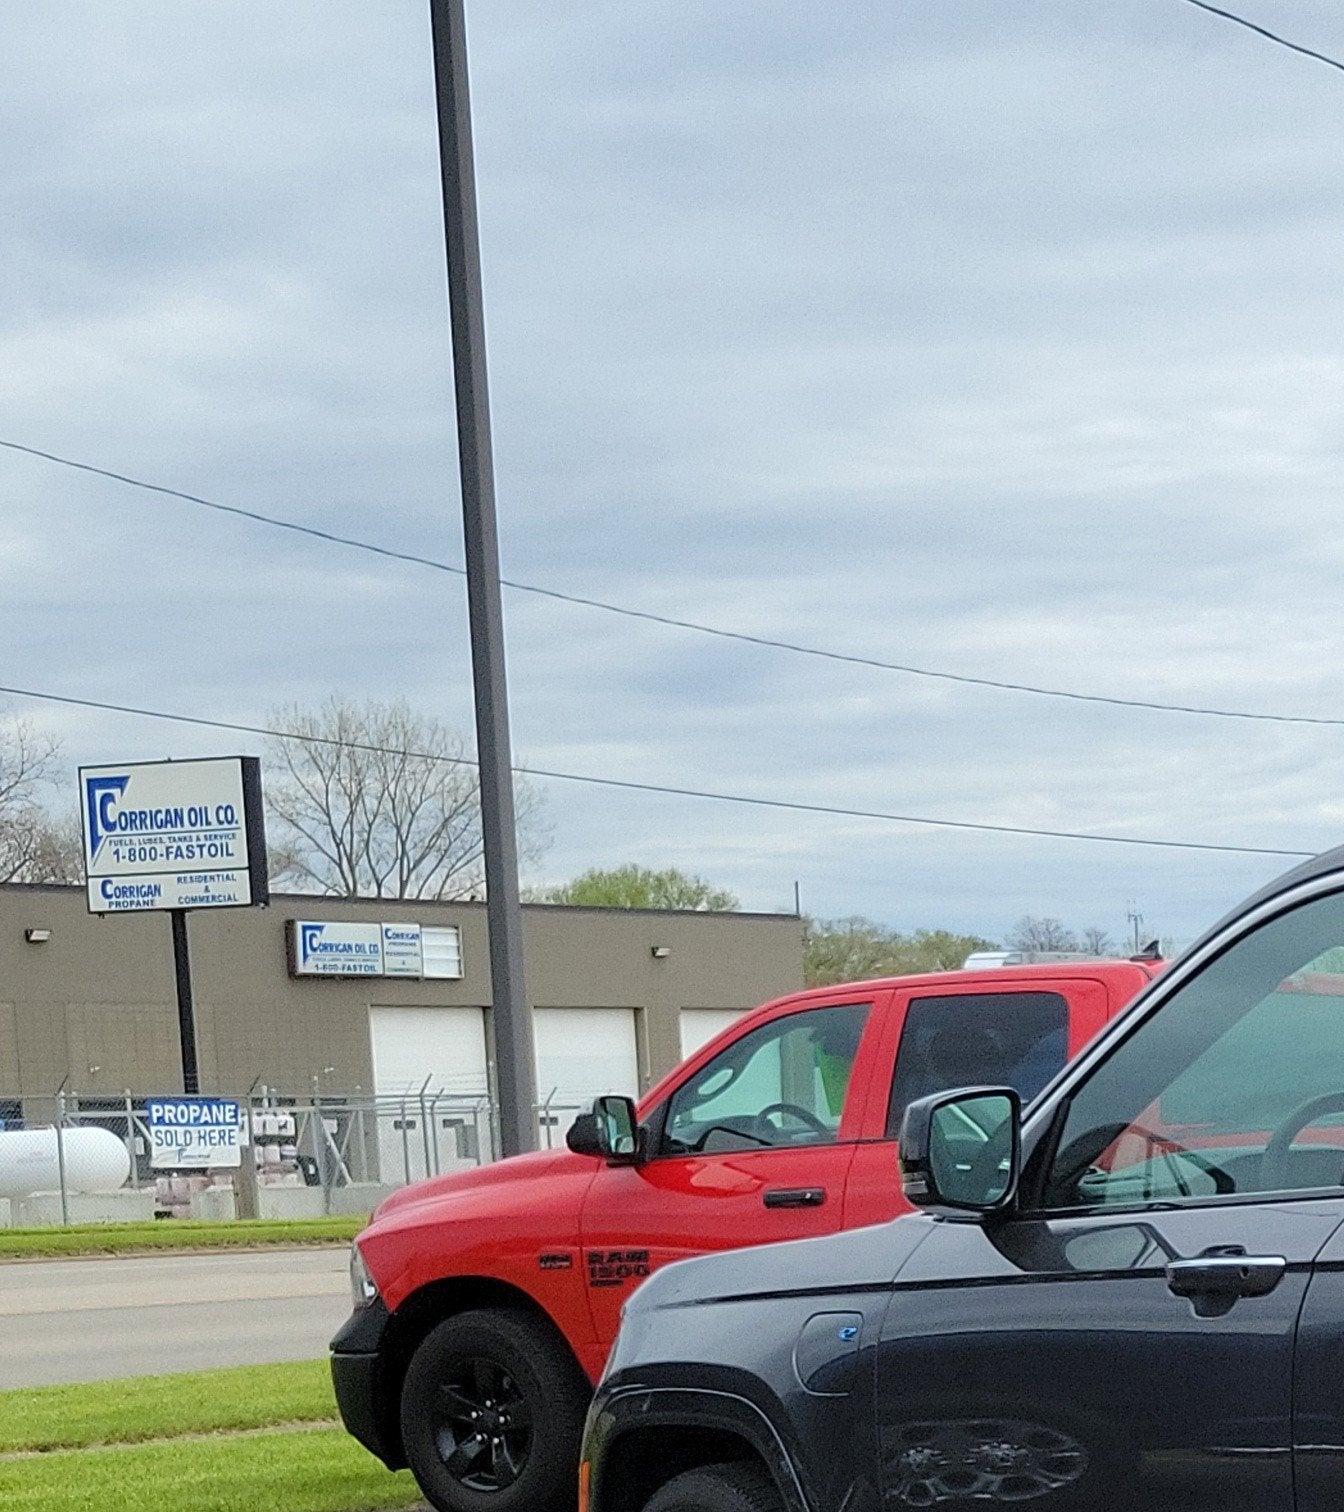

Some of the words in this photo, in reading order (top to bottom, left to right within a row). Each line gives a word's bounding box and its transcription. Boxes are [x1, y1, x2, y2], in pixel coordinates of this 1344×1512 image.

[100, 792, 185, 833] CORRIGAN
[187, 806, 212, 828] OIL
[215, 804, 239, 825] CO.
[168, 835, 194, 844] TANKS
[203, 833, 237, 842] SERVICE
[113, 842, 235, 863] 1-800-FASTOIL
[177, 874, 237, 885] RESIDENTIAL
[101, 879, 162, 900] CORRIGAN
[109, 900, 156, 909] PROPANE
[178, 894, 239, 905] COMMERCIAL
[308, 932, 353, 955] CORRIGAN
[151, 1104, 236, 1123] PROPANE
[154, 1129, 193, 1147] SOLD
[197, 1128, 237, 1146] HERE
